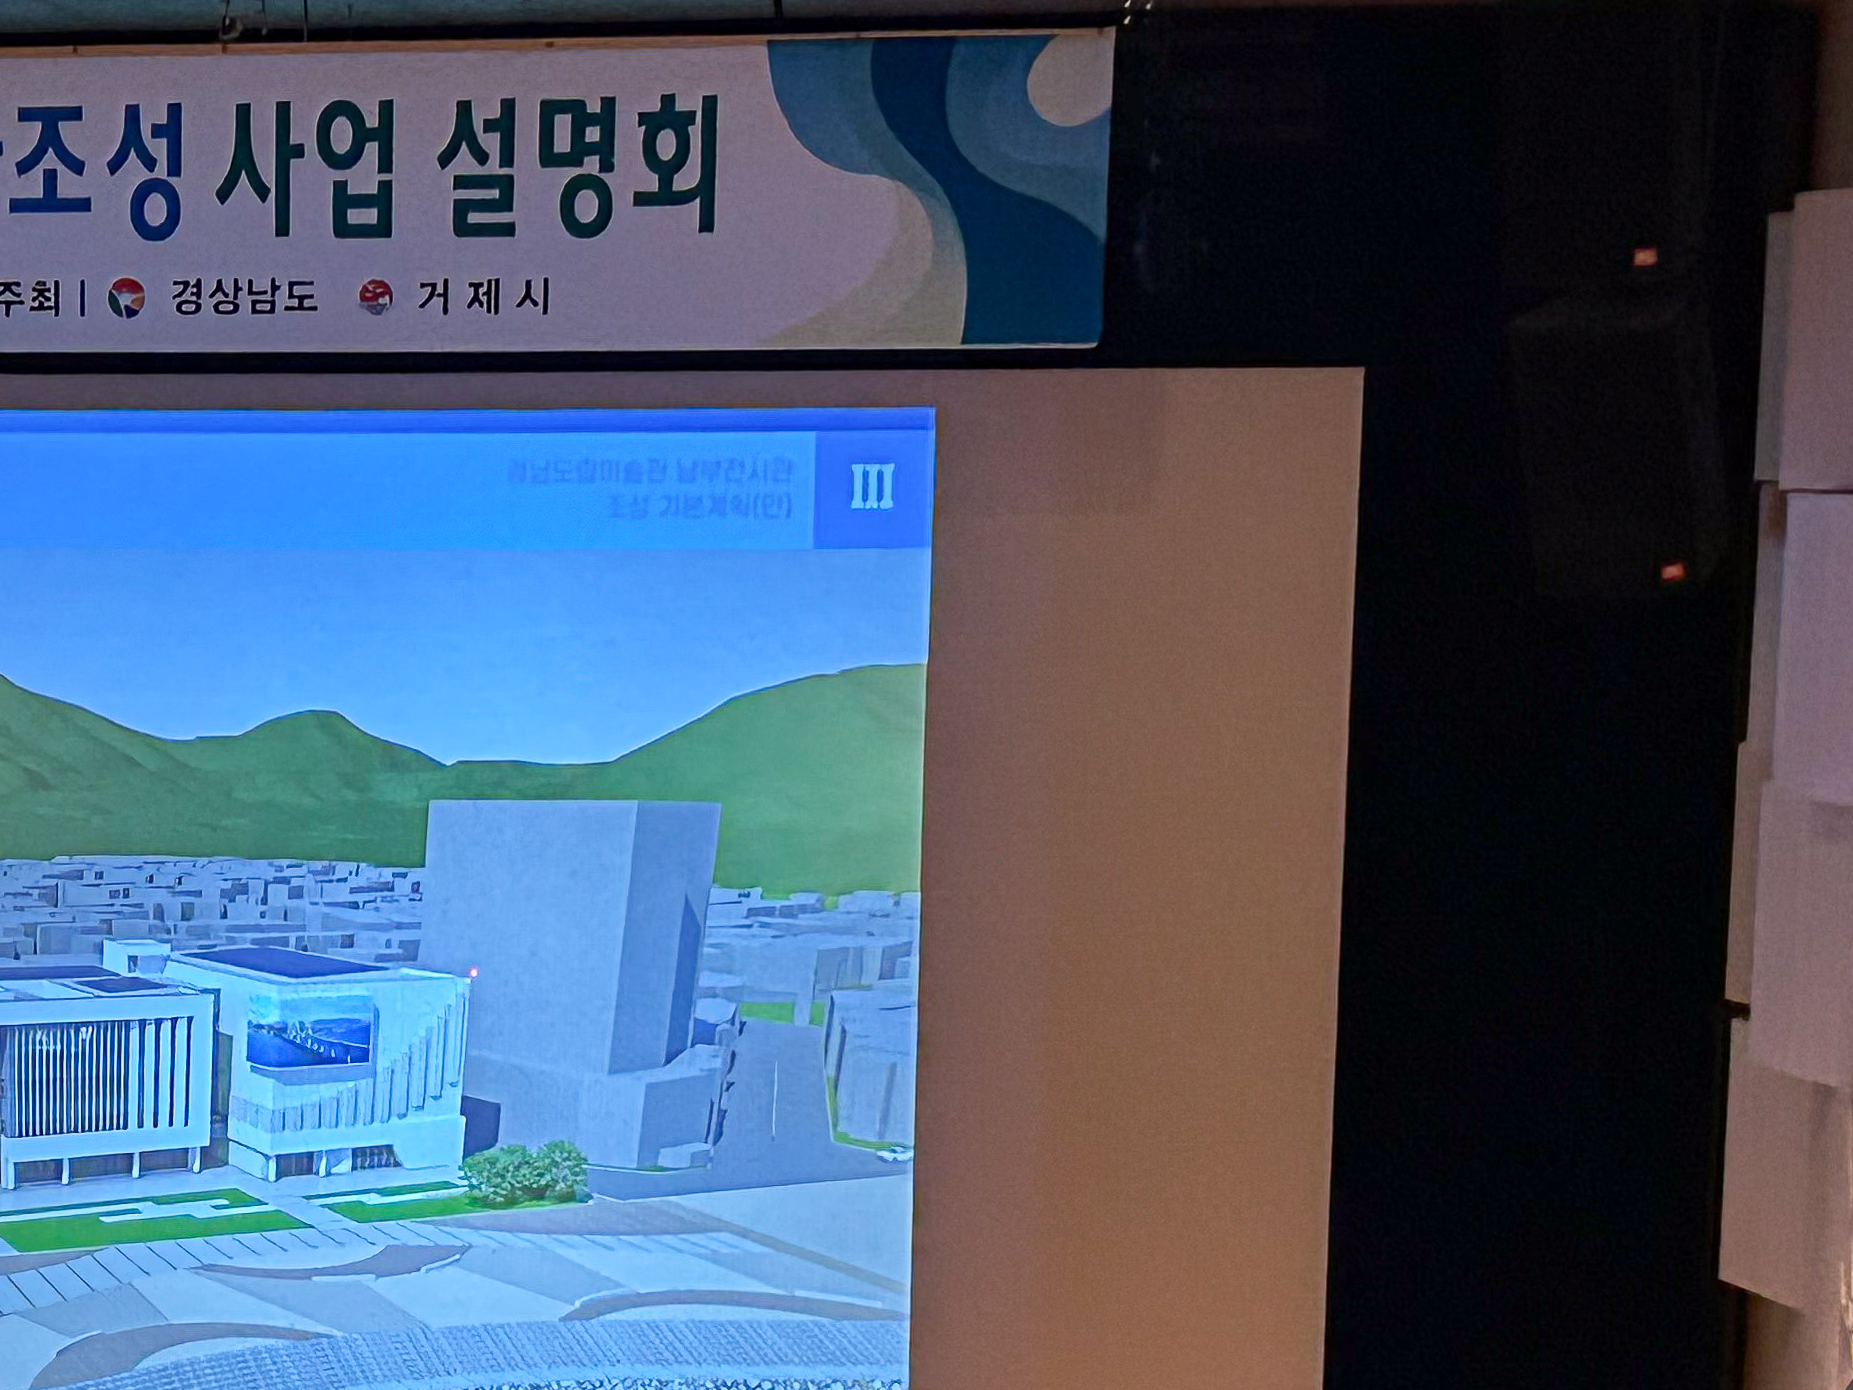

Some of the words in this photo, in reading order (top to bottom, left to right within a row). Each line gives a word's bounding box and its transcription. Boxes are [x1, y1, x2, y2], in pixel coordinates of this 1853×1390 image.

[216, 99, 393, 239] 사업
[437, 93, 717, 238] 설명회
[173, 278, 318, 315] 경상남도
